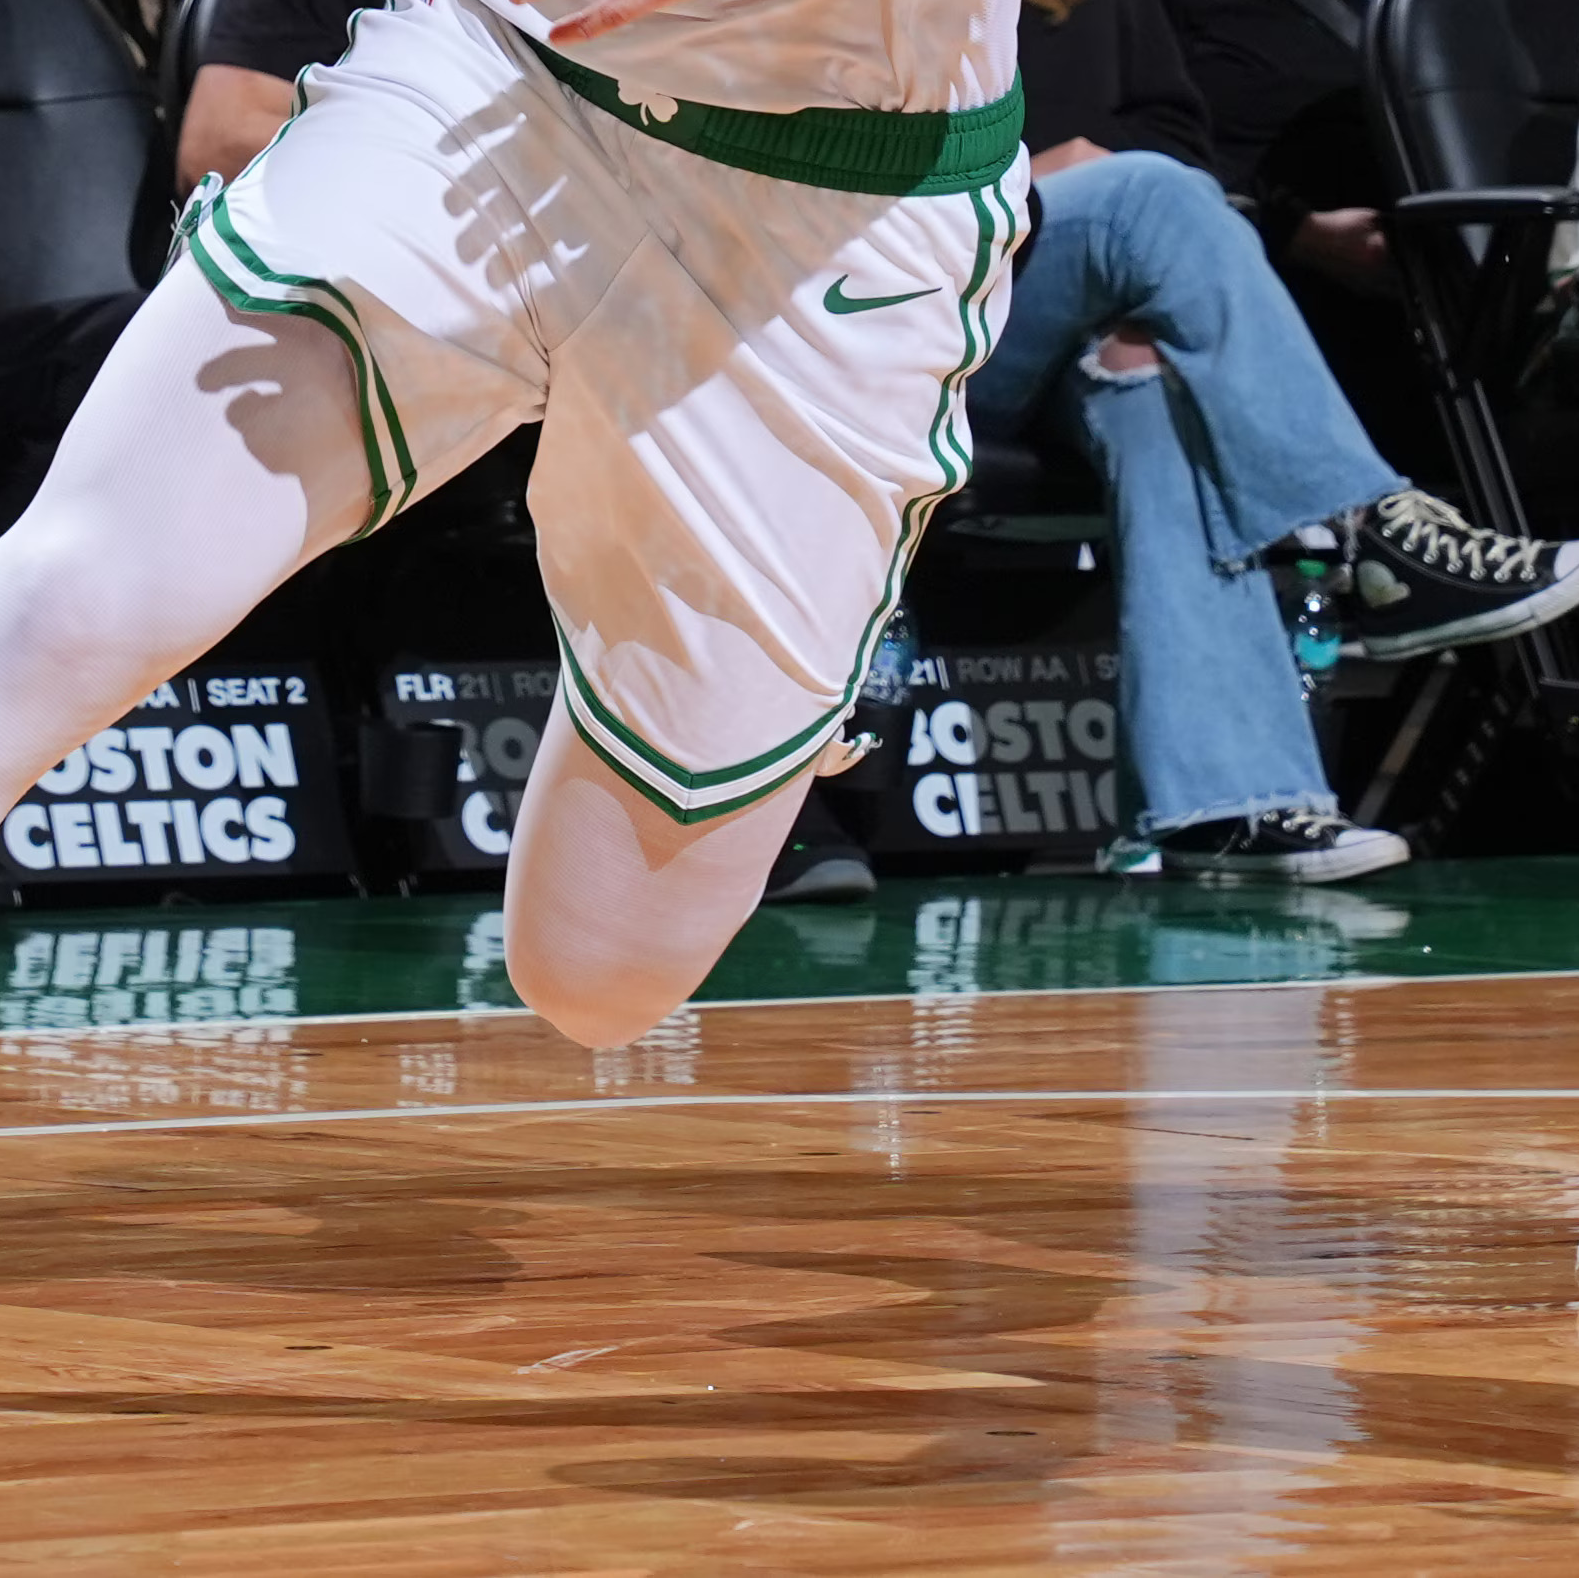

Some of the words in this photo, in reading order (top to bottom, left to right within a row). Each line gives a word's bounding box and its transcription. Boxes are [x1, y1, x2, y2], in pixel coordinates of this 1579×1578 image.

[206, 676, 281, 708] SEAT
[285, 676, 309, 706] 2
[395, 672, 456, 703] FLR
[513, 671, 559, 698] RO
[35, 722, 300, 796] OSTON
[906, 698, 1117, 767] BOSTO
[2, 795, 297, 871] CELTICS
[912, 770, 1118, 838] CELTI
